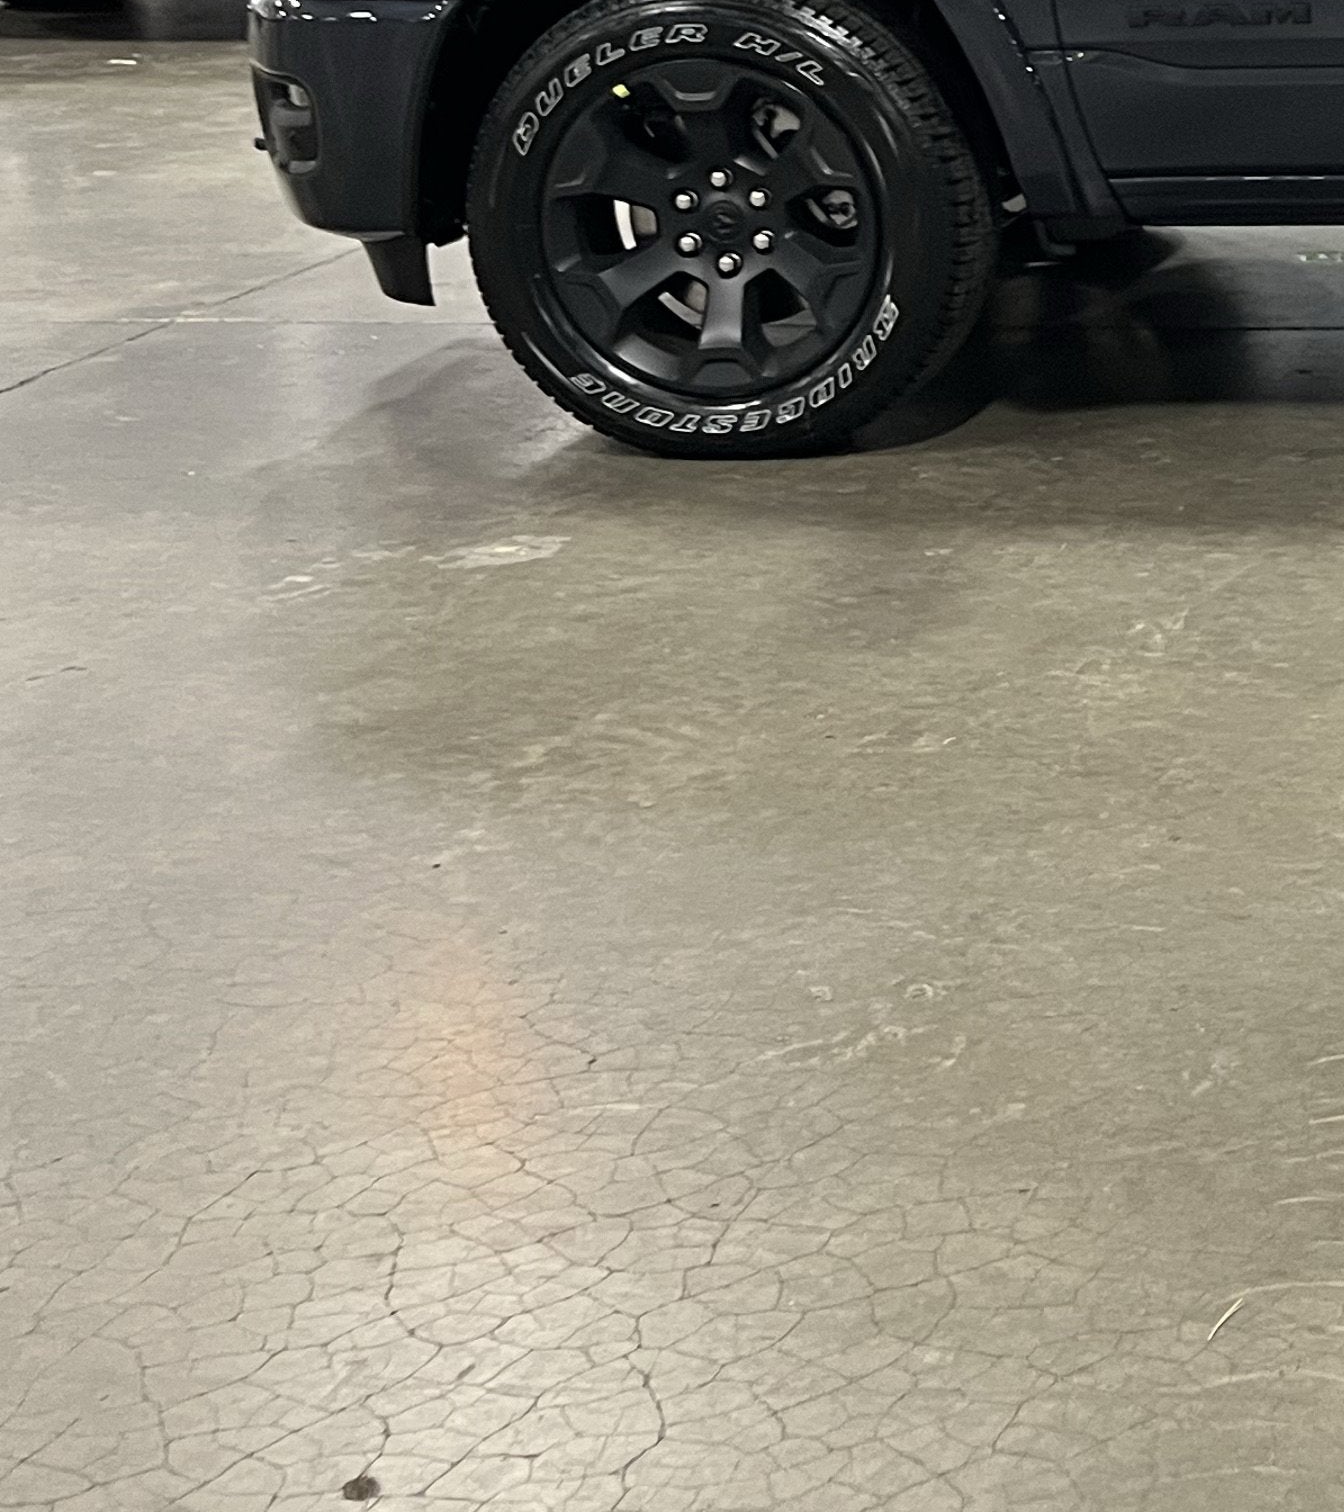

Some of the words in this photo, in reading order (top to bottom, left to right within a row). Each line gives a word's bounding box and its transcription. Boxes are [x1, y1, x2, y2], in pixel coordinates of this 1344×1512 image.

[1128, 1, 1312, 28] RAM
[512, 23, 708, 156] DUELER
[569, 294, 900, 434] BRIDGESTONE
